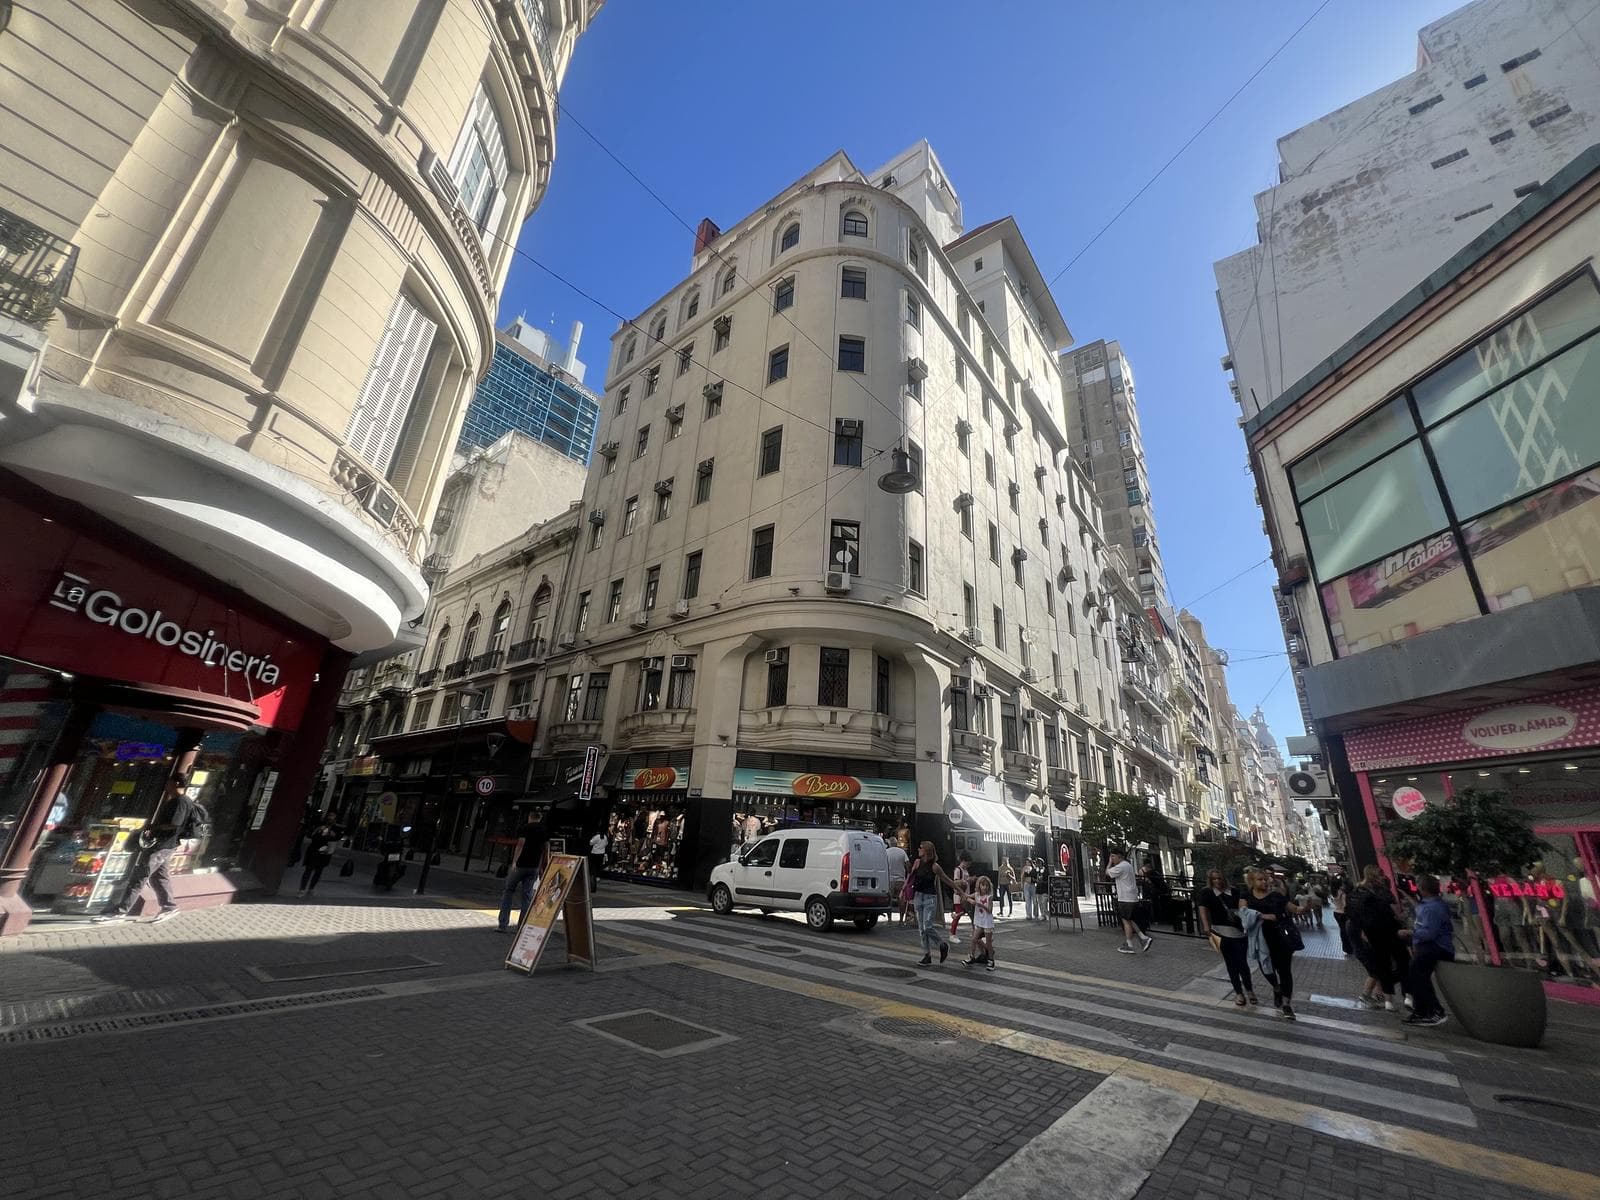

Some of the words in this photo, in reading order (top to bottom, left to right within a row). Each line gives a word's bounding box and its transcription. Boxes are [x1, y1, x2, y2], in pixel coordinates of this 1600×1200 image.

[1408, 535, 1452, 572] COLORS
[53, 579, 86, 604] La
[85, 590, 280, 685] Golosinería
[1470, 723, 1518, 738] VOLVER
[1526, 716, 1569, 732] AMAR
[480, 781, 491, 790] 10
[583, 748, 596, 796] PIZZERIA
